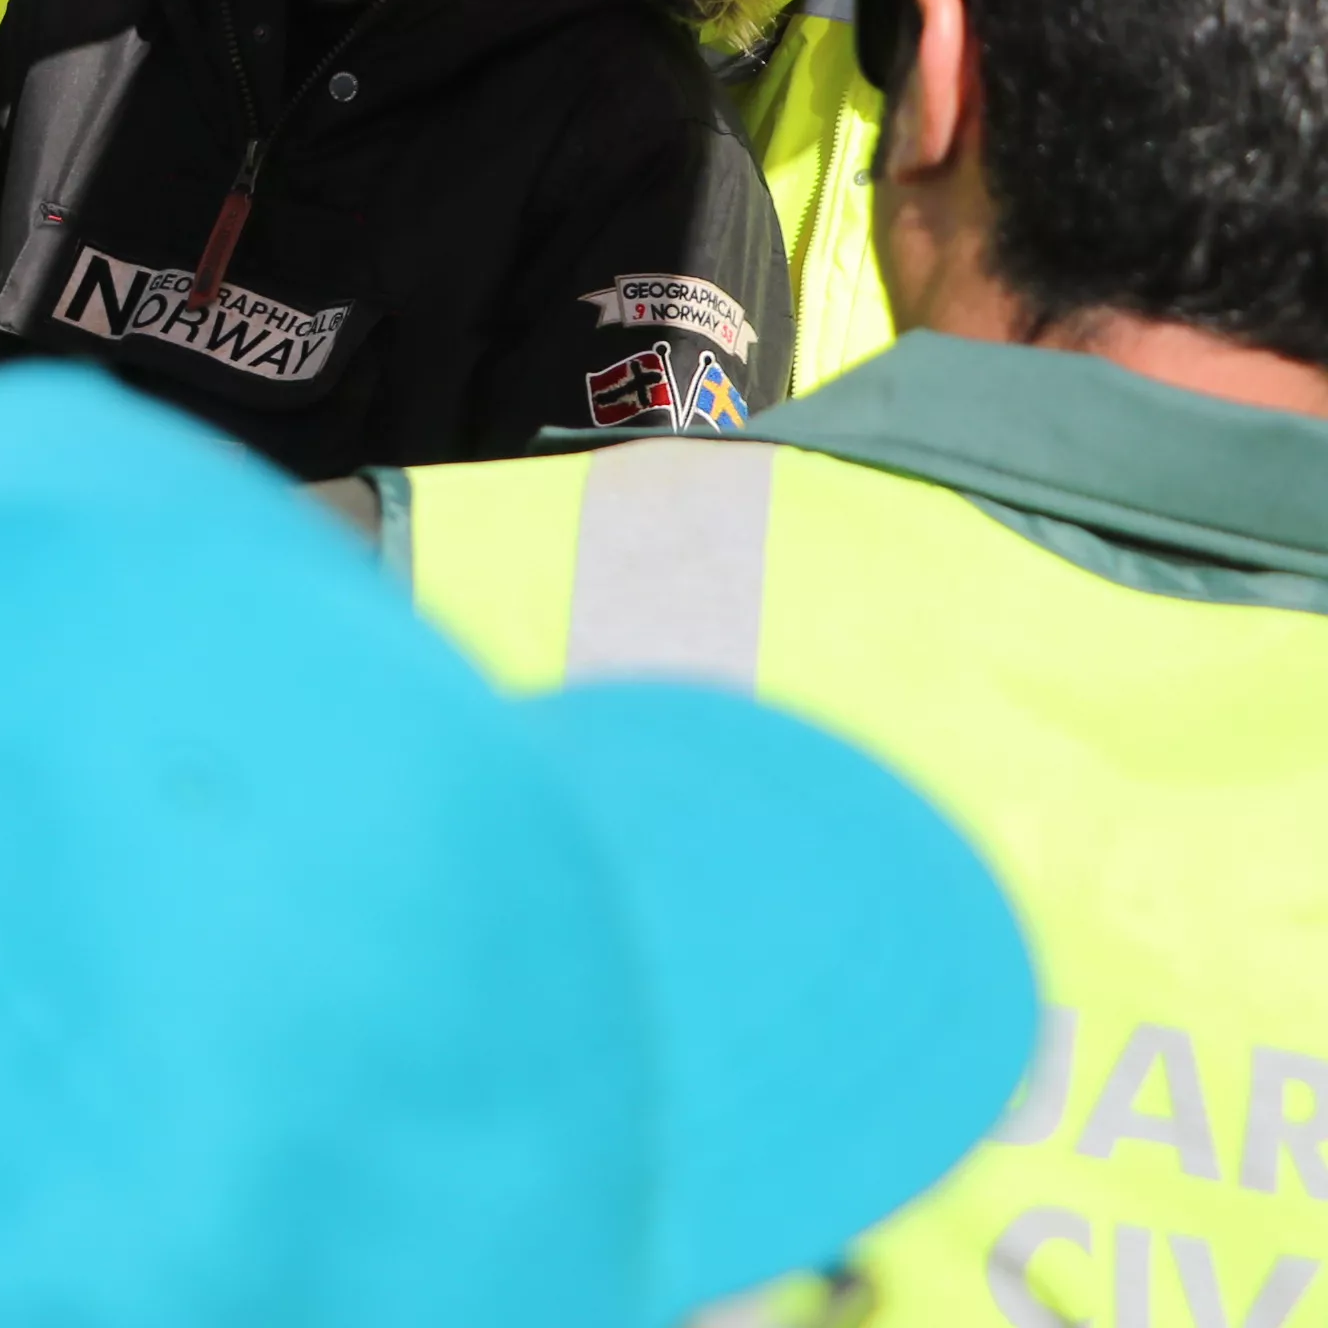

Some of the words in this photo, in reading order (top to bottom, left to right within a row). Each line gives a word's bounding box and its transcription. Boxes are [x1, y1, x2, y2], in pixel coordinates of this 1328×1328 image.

[64, 255, 326, 375] NORWAY
[623, 283, 738, 328] GEOGRAPHICAL
[651, 303, 721, 333] NORWAY
